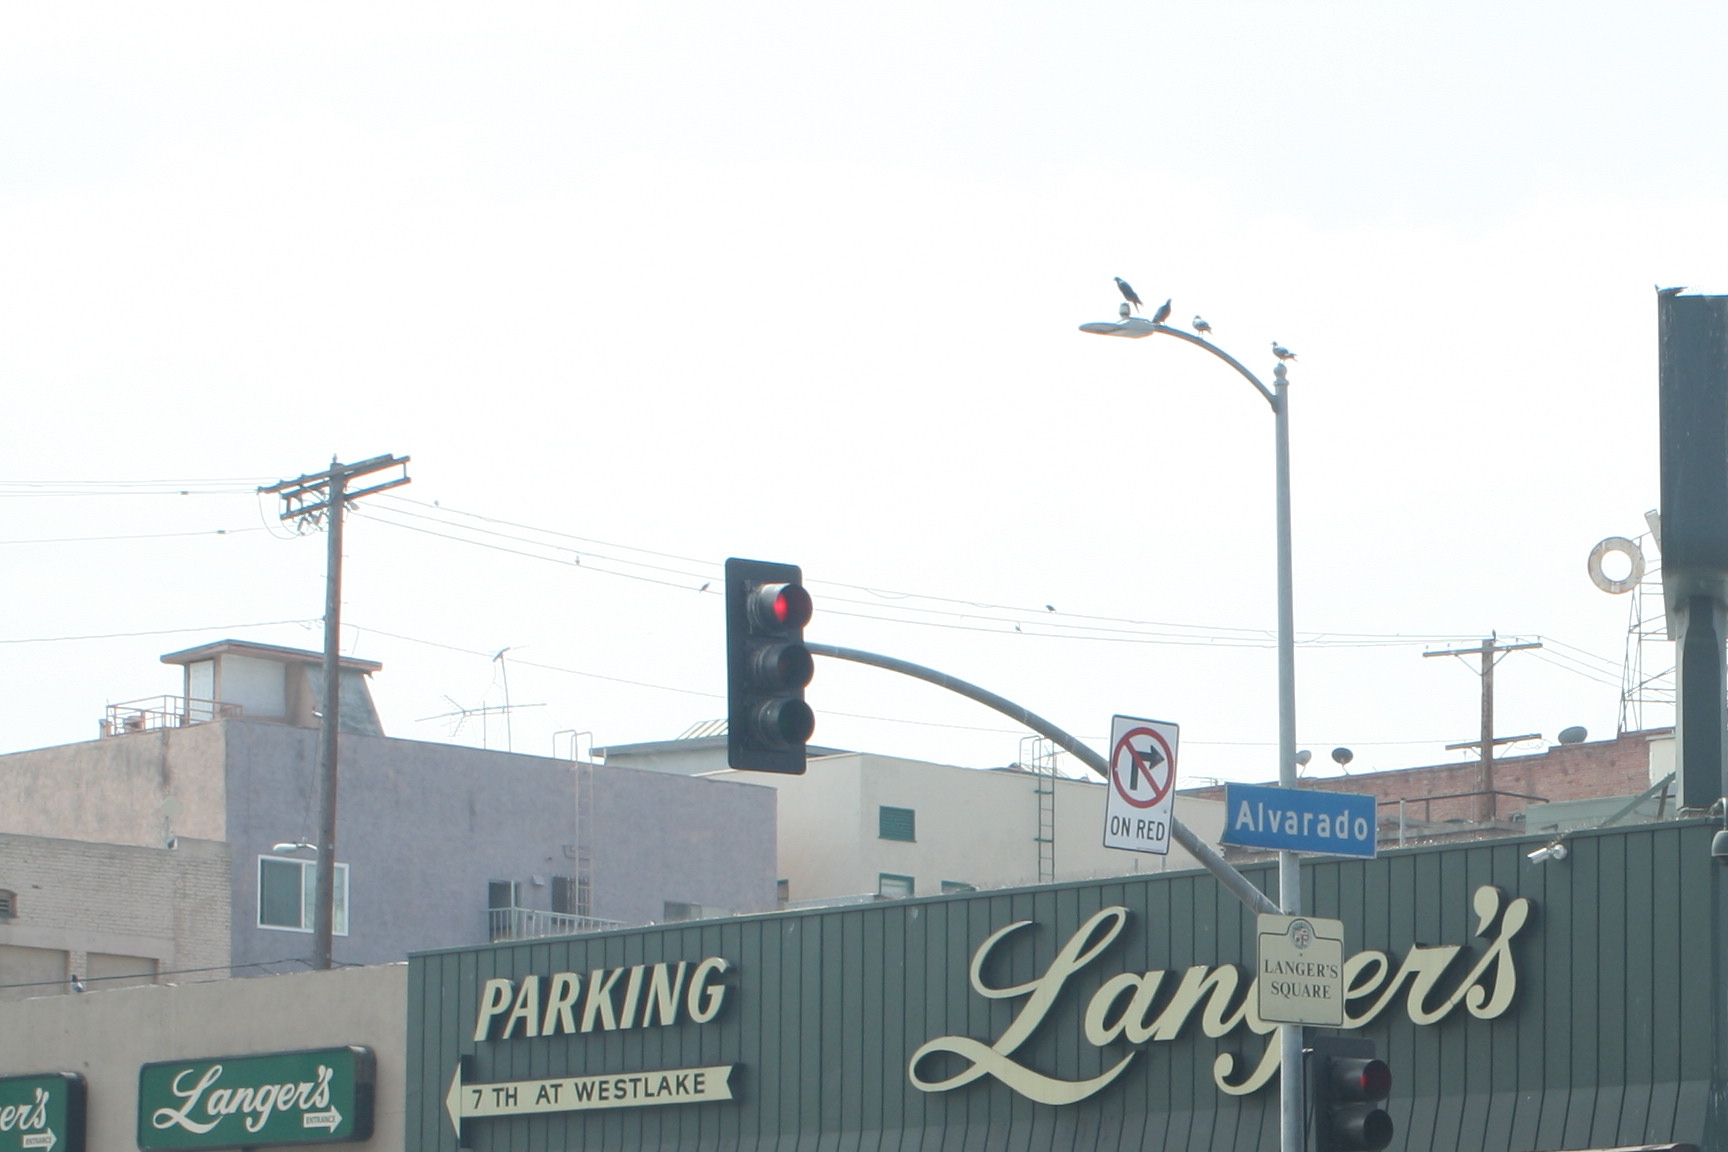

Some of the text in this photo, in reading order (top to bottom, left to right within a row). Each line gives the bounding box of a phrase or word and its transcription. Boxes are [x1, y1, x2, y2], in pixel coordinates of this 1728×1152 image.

[1110, 815, 1165, 842] ON RED
[1235, 801, 1368, 841] Alvarado
[1264, 959, 1338, 979] LANGER'S
[474, 957, 731, 1041] PARKING
[1271, 981, 1331, 999] SQUARE
[153, 1064, 333, 1133] Langer's
[535, 1083, 563, 1105] AT
[575, 1072, 706, 1103] WESTLAKE
[0, 1087, 50, 1131] er's
